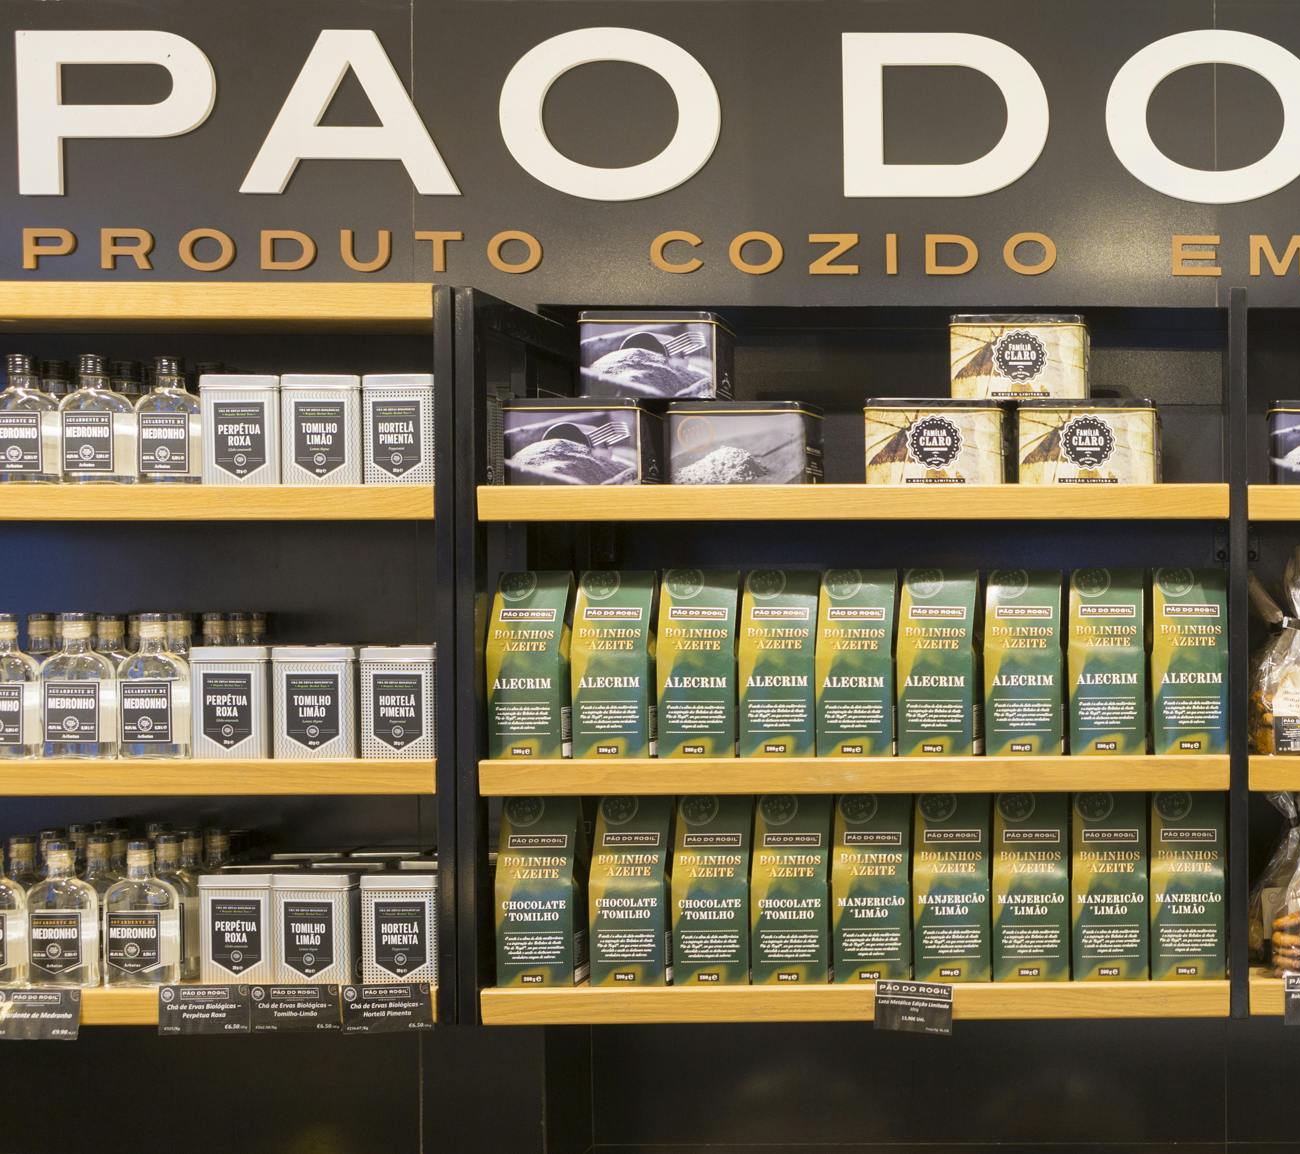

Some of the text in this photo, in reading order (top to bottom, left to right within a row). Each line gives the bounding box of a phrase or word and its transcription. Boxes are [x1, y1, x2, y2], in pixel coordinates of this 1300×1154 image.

[22, 227, 544, 275] PRODUTO
[650, 230, 1059, 277] COZIDO
[1004, 350, 1037, 361] CLARO
[65, 426, 110, 438] MEDRONHO
[218, 422, 261, 435] PERPÉTUA
[301, 423, 338, 434] TOMILHO
[378, 421, 414, 433] HORTELÃ
[142, 428, 185, 440] MEDRONHO
[306, 434, 333, 445] LIMÃO
[379, 433, 414, 445] PIMENTA
[227, 436, 251, 446] ROXA
[919, 436, 952, 447] CLARO
[1072, 436, 1105, 447] CLARO
[579, 628, 641, 639] BOLINHOS
[665, 627, 728, 639] BOLINHOS
[992, 626, 1053, 637] BOLINHOS
[588, 639, 634, 650] AZEITE
[674, 640, 721, 650] AZEITE
[1001, 638, 1047, 649] AZEITE
[578, 676, 640, 688] ALECRIM
[664, 676, 727, 688] ALECRIM
[746, 675, 808, 688] ALECRIM
[823, 676, 884, 688] ALECRIM
[904, 675, 965, 687] ALECRIM
[992, 674, 1053, 686] ALECRIM
[1076, 672, 1137, 685] ALECRIM
[1162, 672, 1222, 684] ALECRIM
[493, 678, 551, 690] ALECRIM
[47, 697, 96, 709] MEDRONHO
[124, 697, 167, 709] MEDRONHO
[206, 694, 248, 706] PERPÉTUA
[293, 695, 331, 707] TOMILHO
[379, 694, 416, 706] HORTELÃ
[216, 707, 238, 717] ROXA
[299, 707, 326, 718] LIMÃO
[379, 707, 415, 718] PIMENTA
[598, 854, 659, 865] BOLINHOS
[679, 855, 741, 866] BOLINHOS
[606, 866, 651, 877] AZEITE
[688, 867, 734, 878] AZEITE
[595, 898, 657, 908] CHOCOLATE
[837, 895, 906, 907] MANJERICÃO
[918, 893, 985, 904] MANJERICÃO
[997, 893, 1065, 904] MANJERICÃO
[1077, 893, 1144, 904] MANJERICÃO
[1155, 892, 1222, 903] MANJERICÃO
[502, 900, 566, 910] CHOCOLATE
[678, 898, 741, 909] CHOCOLATE
[758, 898, 821, 909] CHOCOLATE
[1171, 903, 1205, 915] LIMÃO
[602, 909, 651, 920] TOMILHO
[685, 910, 734, 920] TOMILHO
[764, 910, 814, 920] TOMILHO
[854, 907, 888, 918] LIMÃO
[934, 904, 969, 916] LIMÃO
[1014, 904, 1048, 916] LIMÃO
[1093, 904, 1128, 916] LIMÃO
[508, 911, 559, 922] TOMILHO
[214, 920, 257, 933] PERPÉTUA
[290, 923, 326, 935] TOMILHO
[381, 922, 419, 934] HORTELÃ
[32, 927, 77, 940] MEDRONHO
[109, 927, 156, 940] MEDRONHO
[224, 933, 248, 943] ROXA
[295, 934, 321, 946] LIMÃO
[382, 934, 419, 945] PIMENTA
[206, 1002, 236, 1010] Biológicas
[389, 1001, 419, 1009] Biológicas
